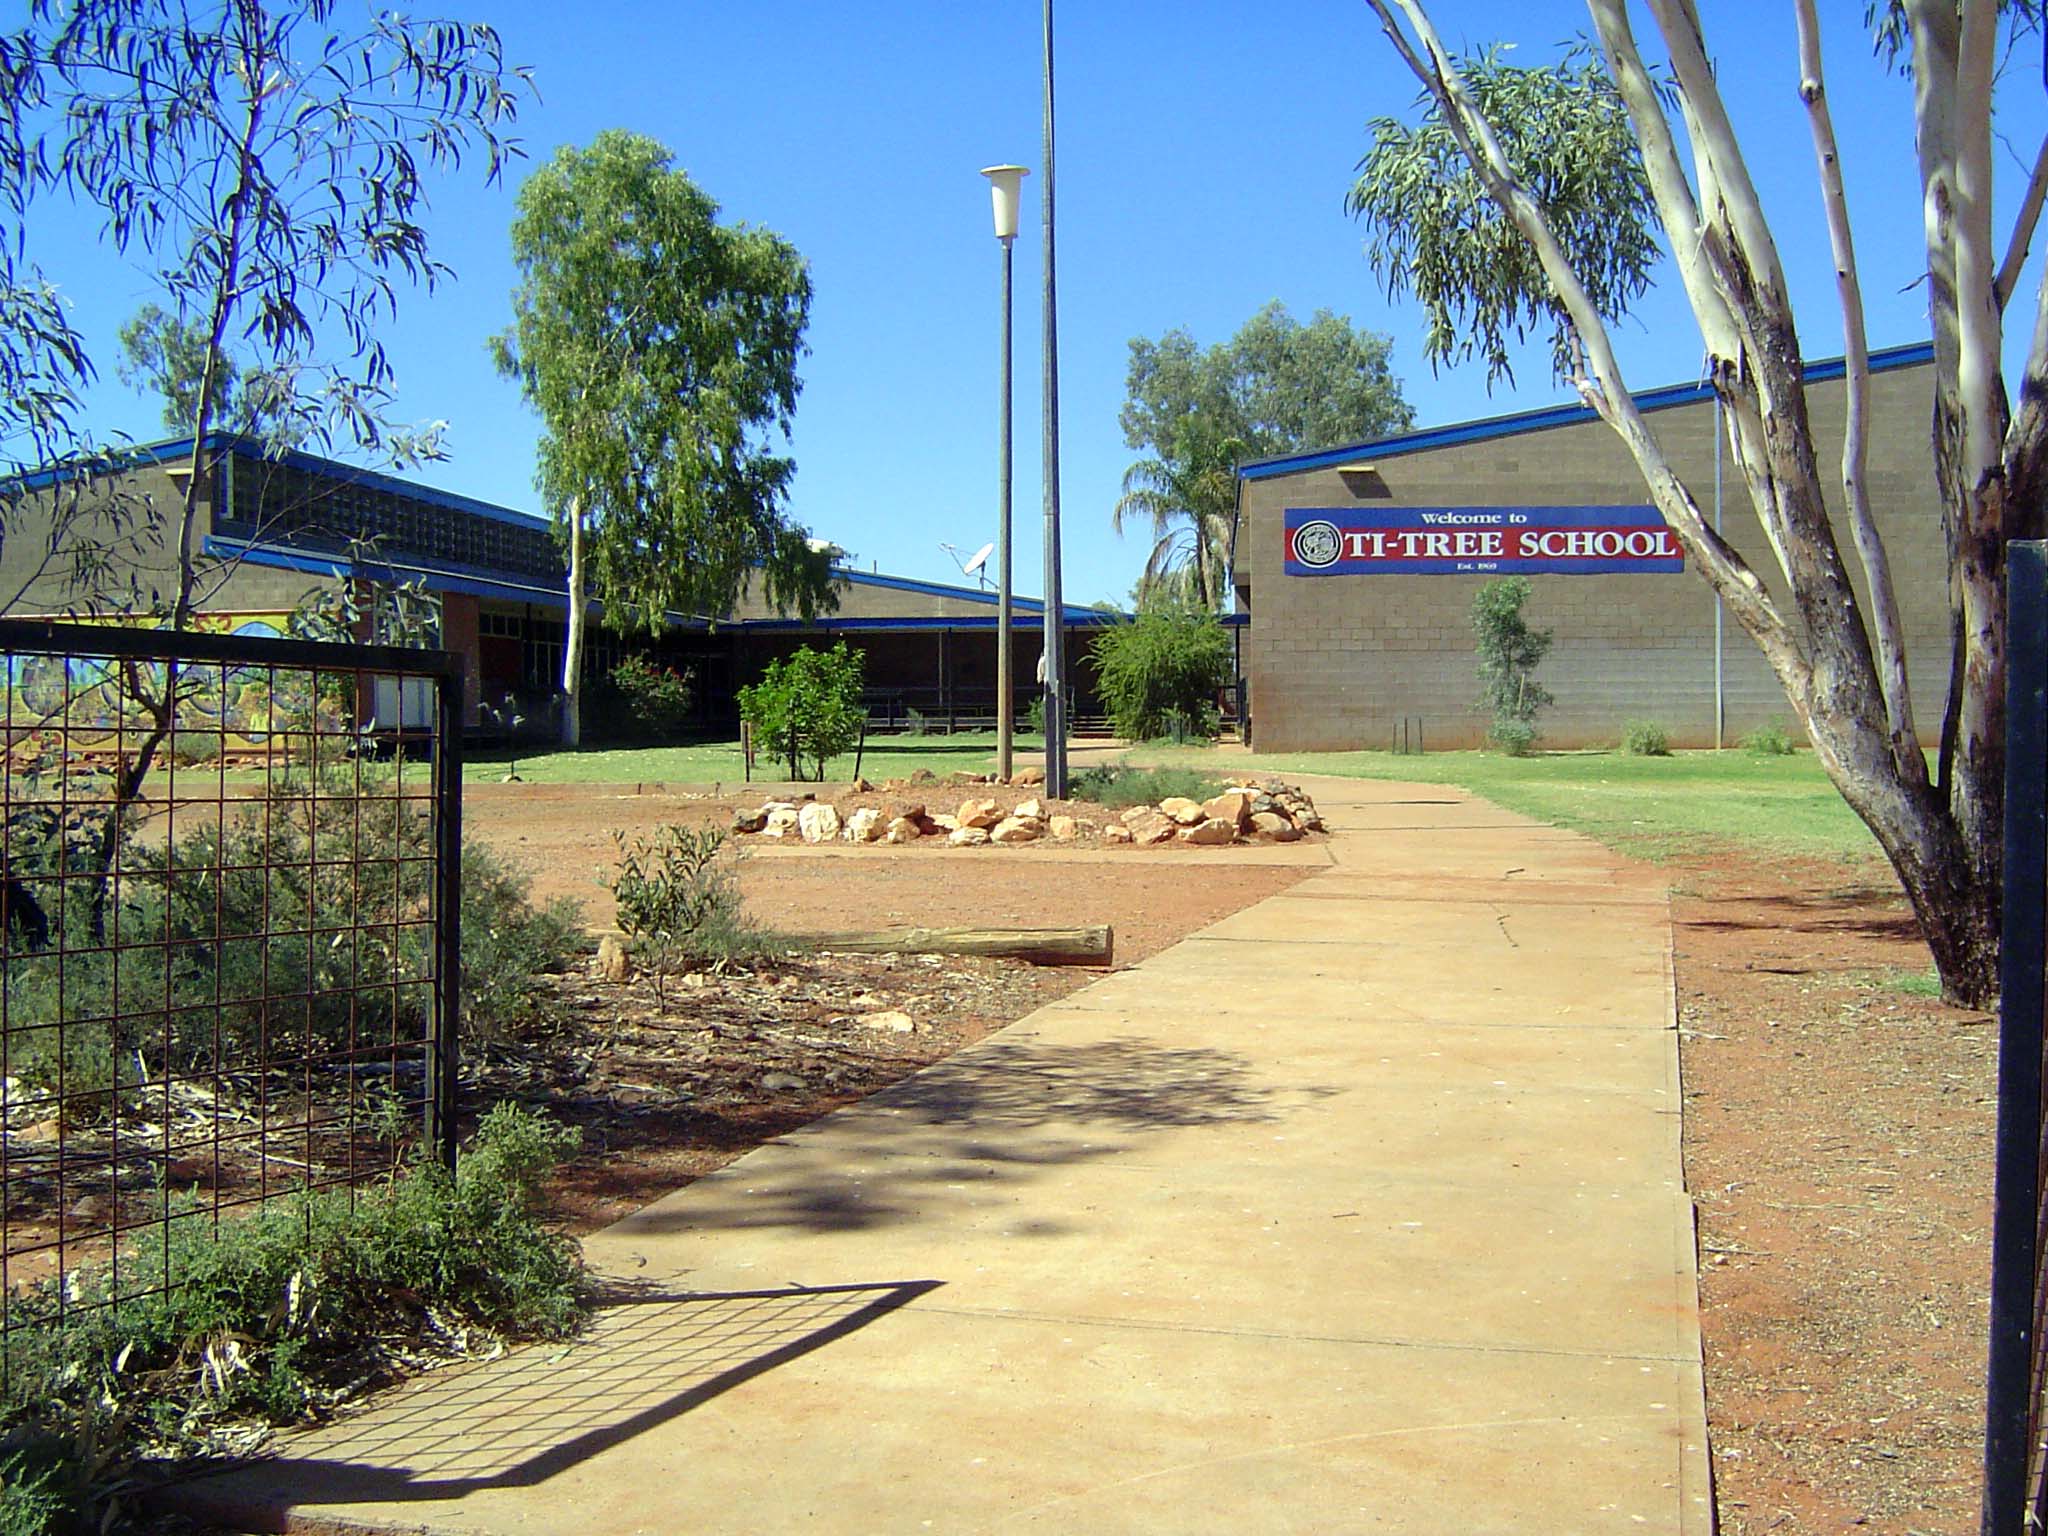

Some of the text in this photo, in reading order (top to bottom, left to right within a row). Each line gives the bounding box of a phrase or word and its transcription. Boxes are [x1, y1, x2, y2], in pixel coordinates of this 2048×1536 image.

[1421, 512, 1528, 524] Welcome to
[1344, 531, 1676, 557] TI-TREE SCHOOL
